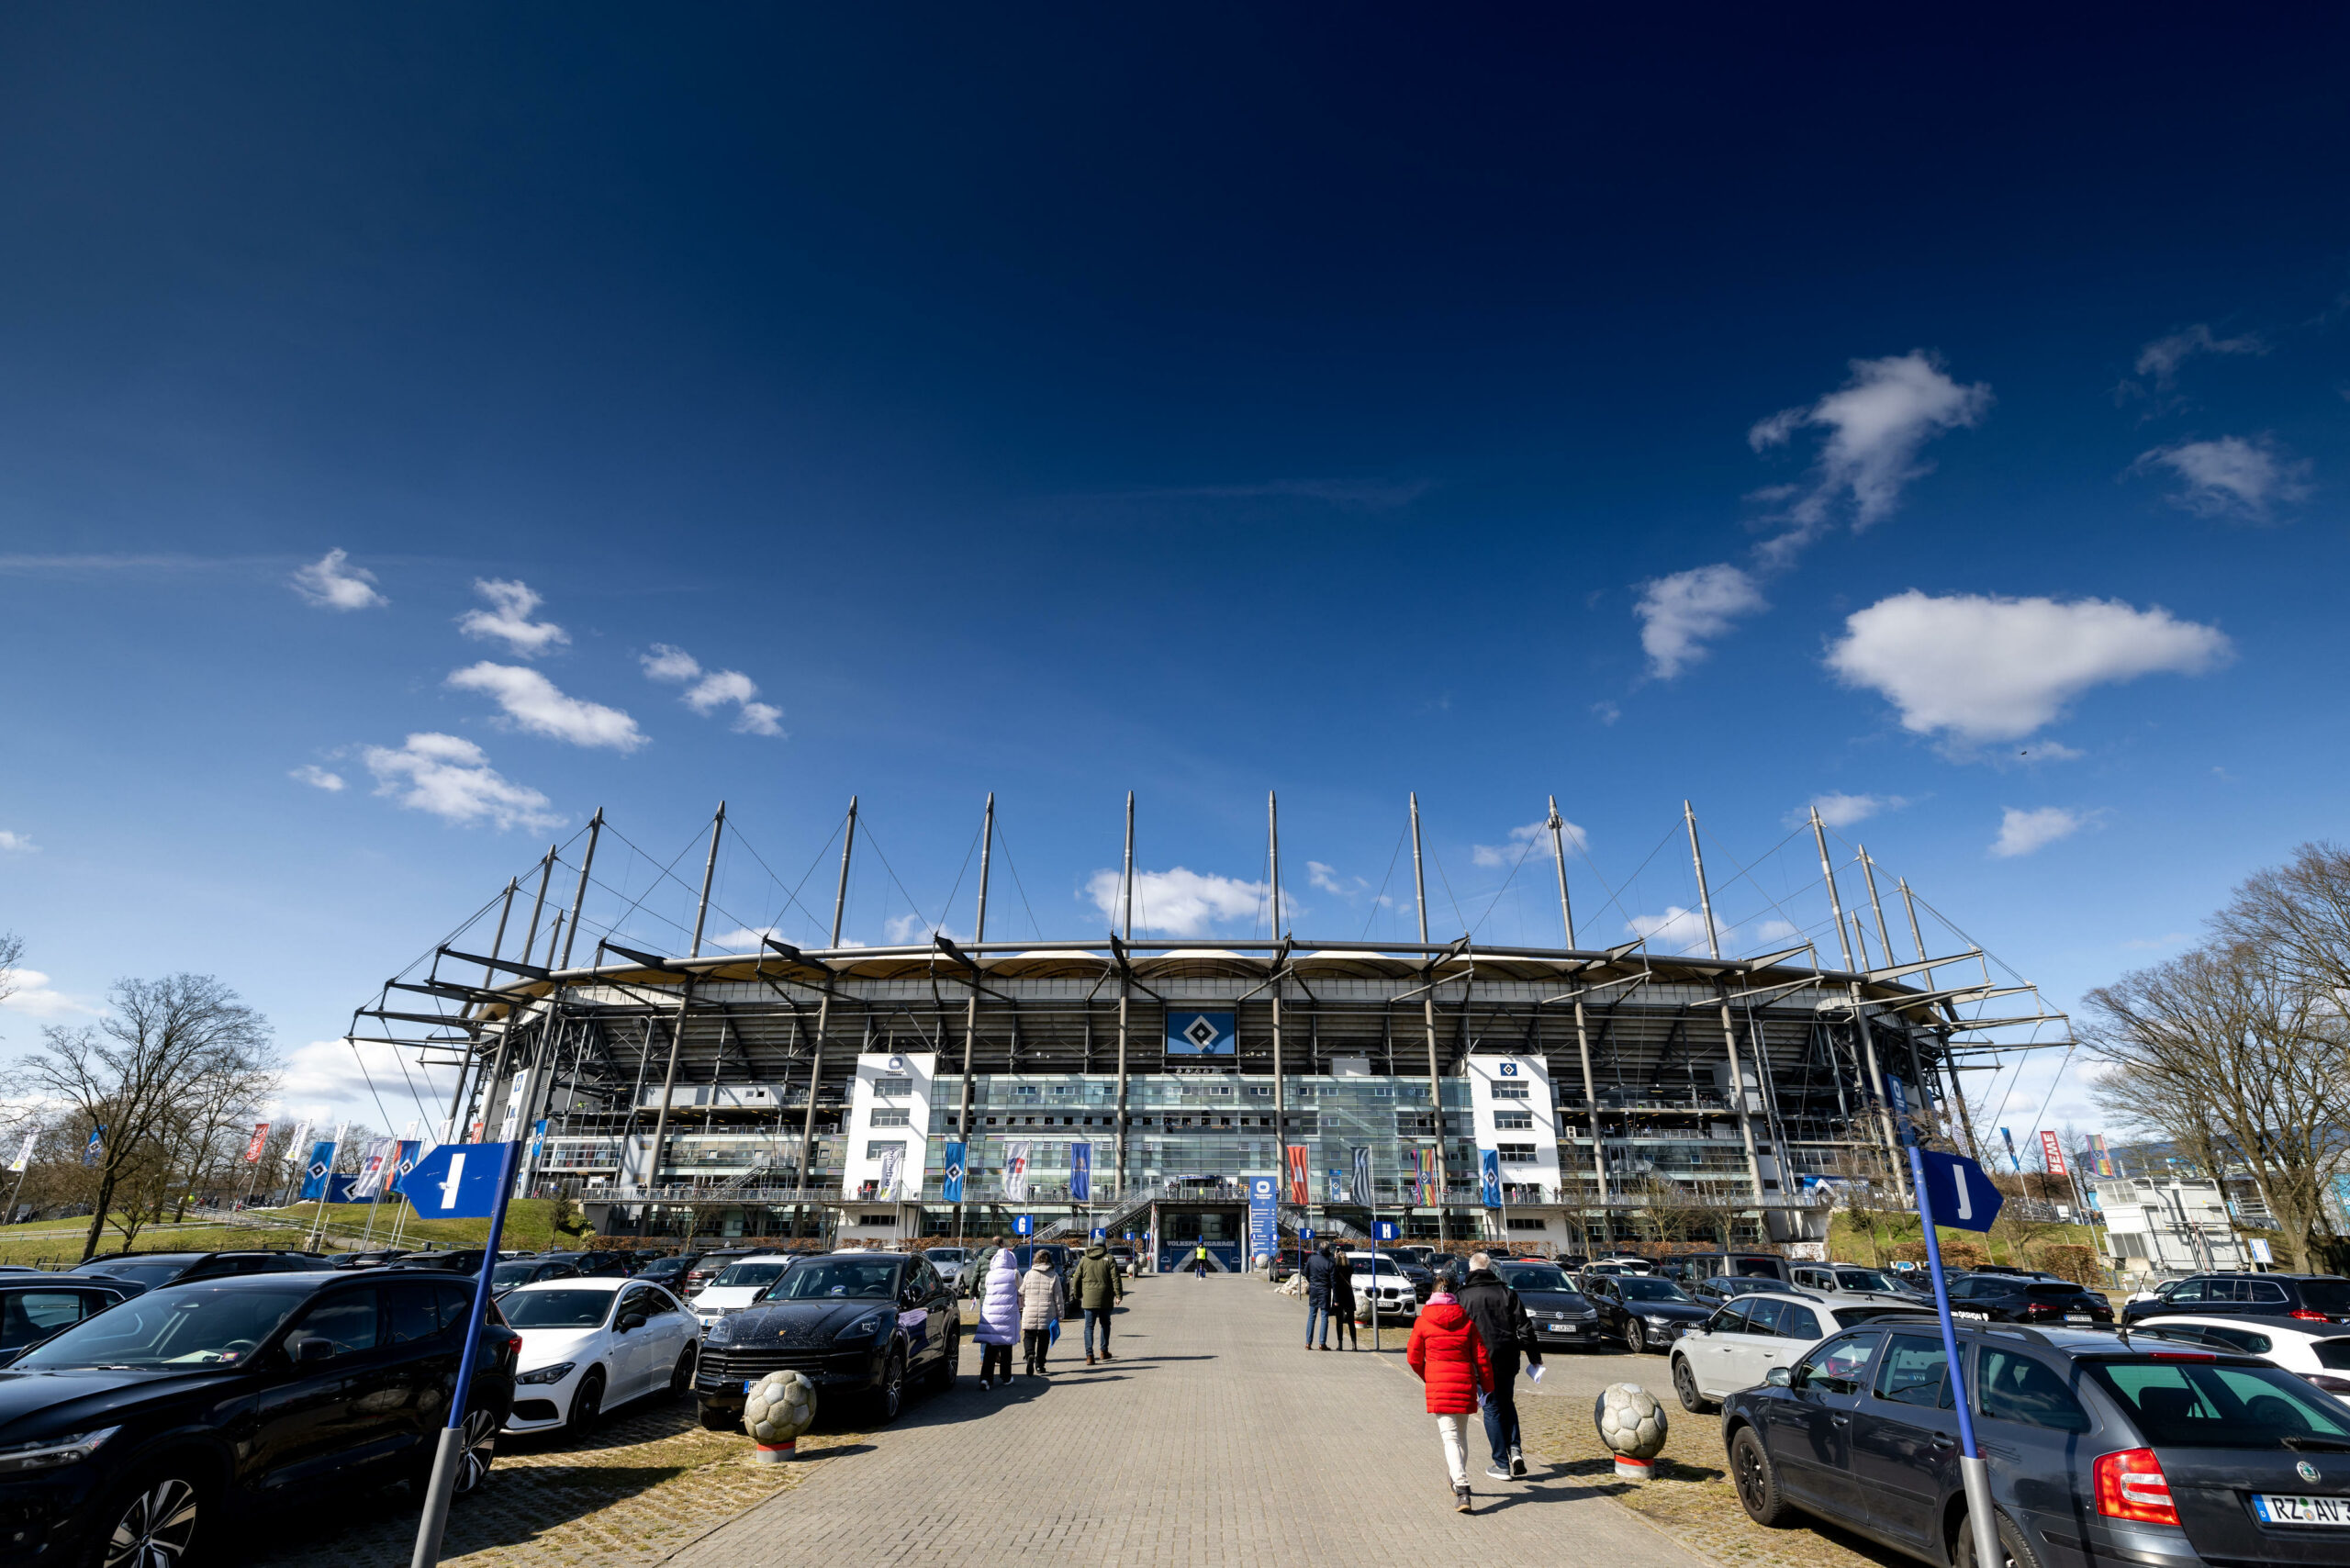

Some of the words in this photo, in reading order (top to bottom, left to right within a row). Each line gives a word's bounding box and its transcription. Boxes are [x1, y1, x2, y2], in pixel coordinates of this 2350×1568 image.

[1952, 1163, 1973, 1220] J
[1018, 1217, 1026, 1233] G
[1382, 1223, 1392, 1239] H
[1305, 1229, 1311, 1238] F
[2271, 1497, 2304, 1520] RZ
[2313, 1499, 2339, 1522] AV
